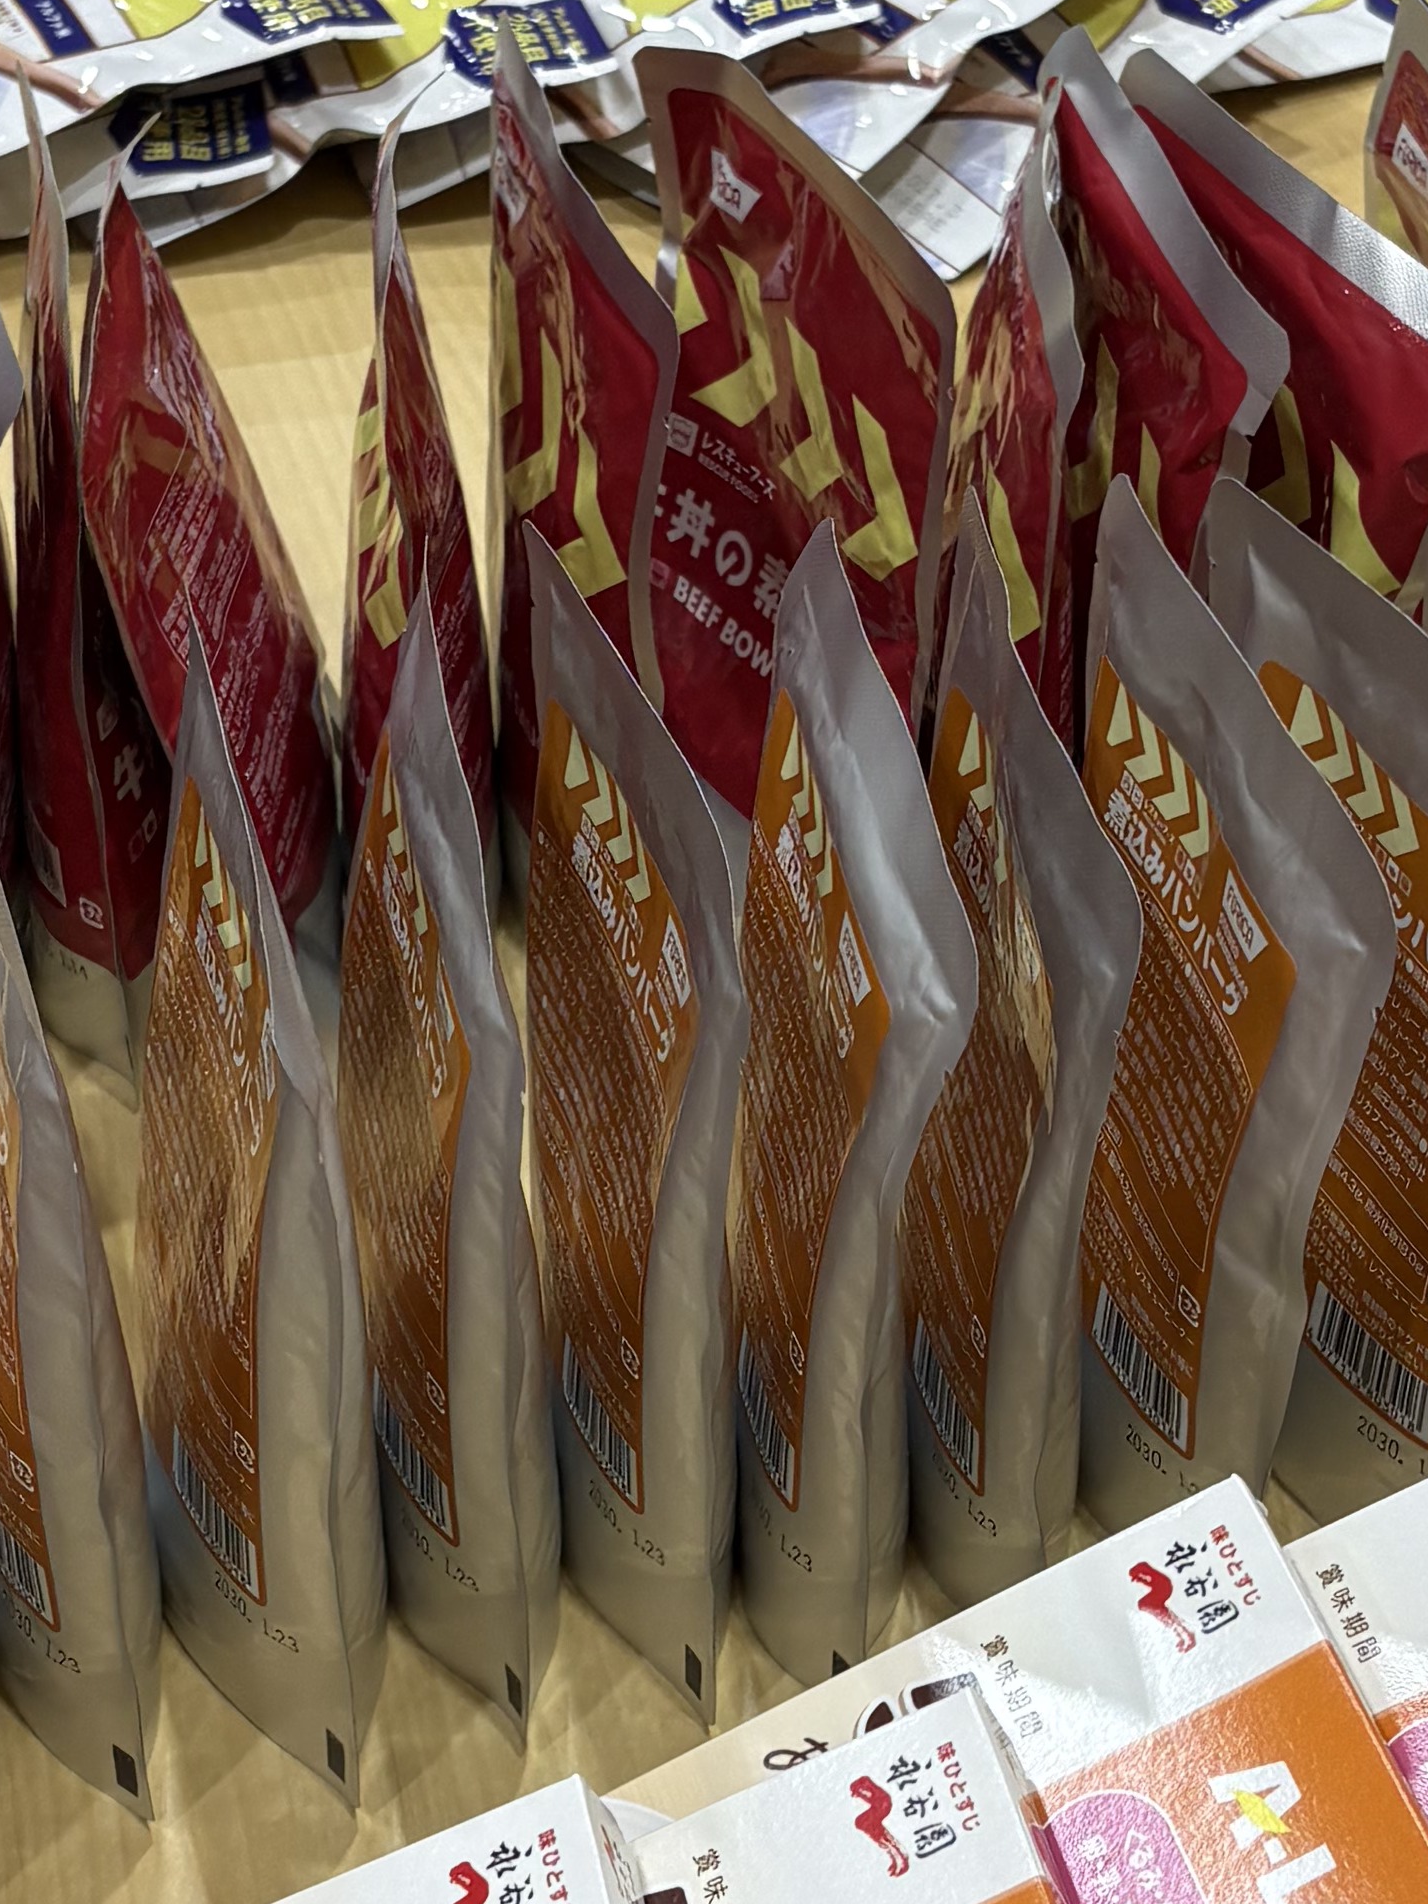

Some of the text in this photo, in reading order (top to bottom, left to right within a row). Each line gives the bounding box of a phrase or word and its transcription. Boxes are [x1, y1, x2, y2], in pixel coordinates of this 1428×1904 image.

[655, 484, 789, 623] 丼の素
[674, 575, 722, 627] BEEF
[1104, 789, 1242, 1015] 煮込みハンバーグ
[1357, 1415, 1404, 1465] 2030.
[1313, 1563, 1381, 1665] 賞味期間
[980, 1633, 1047, 1737] 賞味期間
